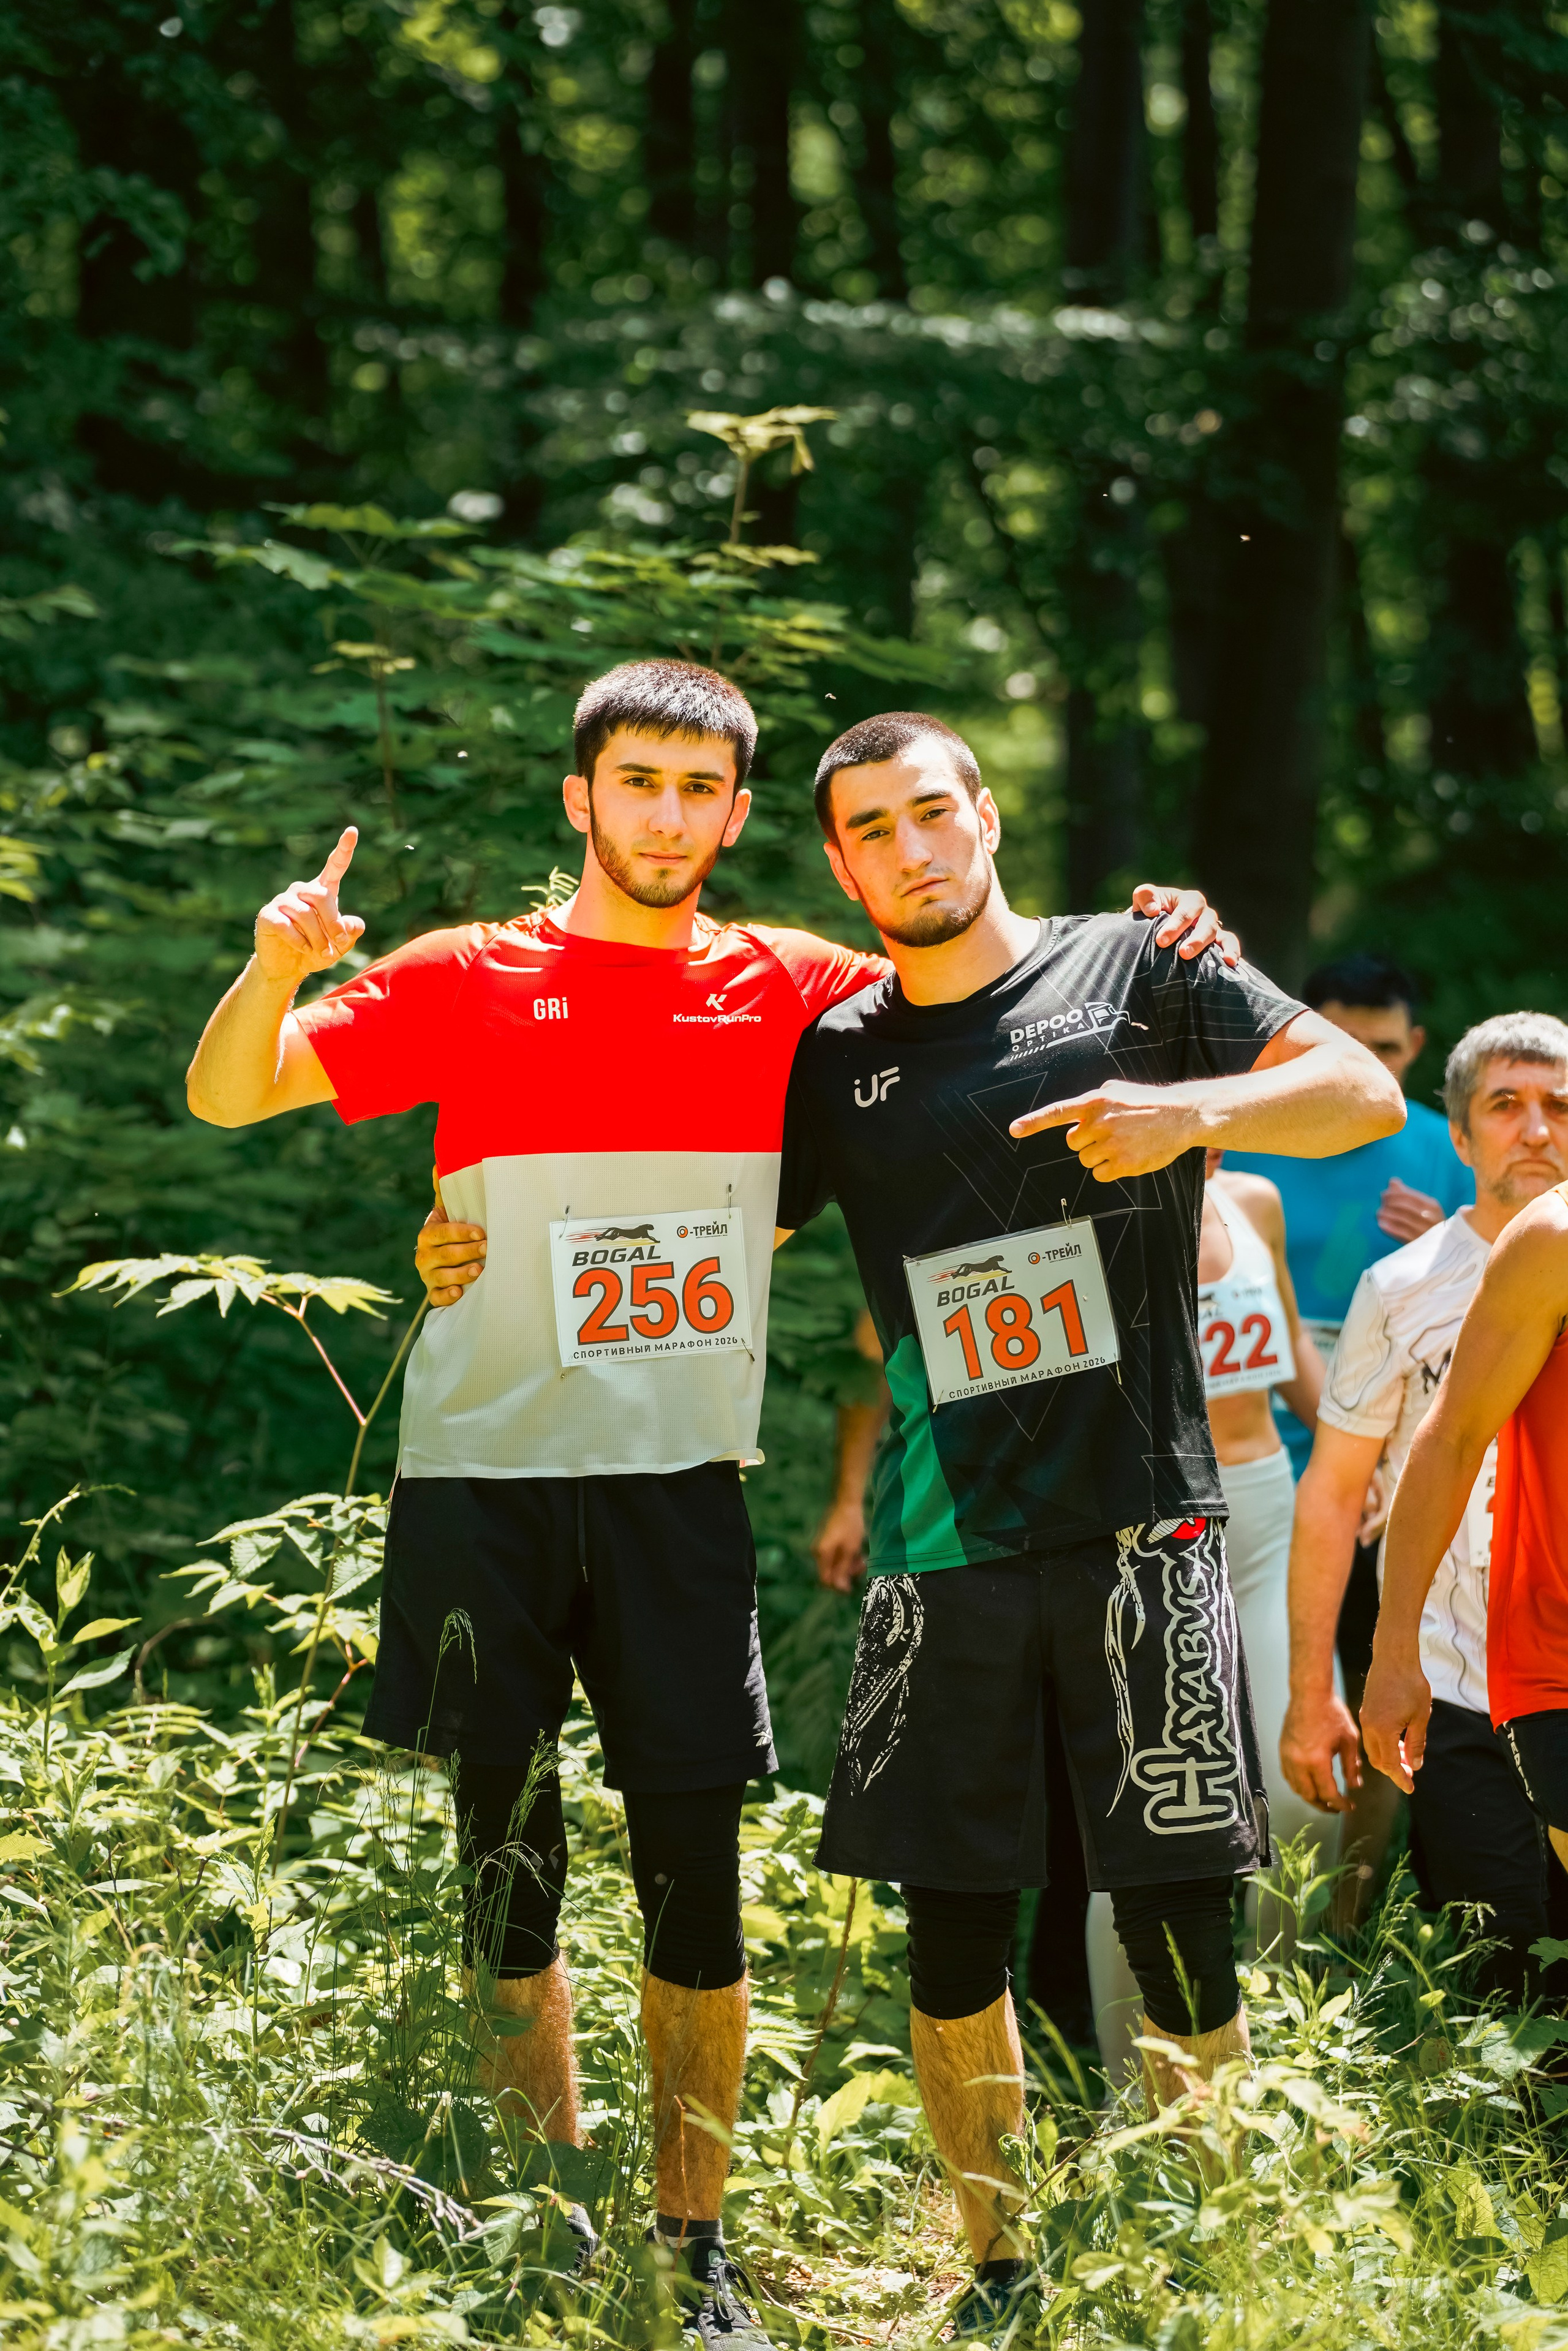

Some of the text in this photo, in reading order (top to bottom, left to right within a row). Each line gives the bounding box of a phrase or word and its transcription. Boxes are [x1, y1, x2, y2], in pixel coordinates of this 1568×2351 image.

[673, 1013, 762, 1025] KustovRunPro
[1010, 1008, 1084, 1044] DEPOO
[571, 1245, 662, 1267] BOGAL
[572, 1256, 734, 1346] 256
[937, 1275, 1015, 1307] BOGAL
[942, 1278, 1089, 1381] 181
[573, 1344, 651, 1359] СПОРТИВНЫЙ
[654, 1338, 712, 1351] МАРАФОН
[949, 1376, 1017, 1399] СПОРТИВНЫЙ
[1020, 1362, 1080, 1383] МАРАФОН
[1143, 1530, 1232, 1820] HAYABUSA
